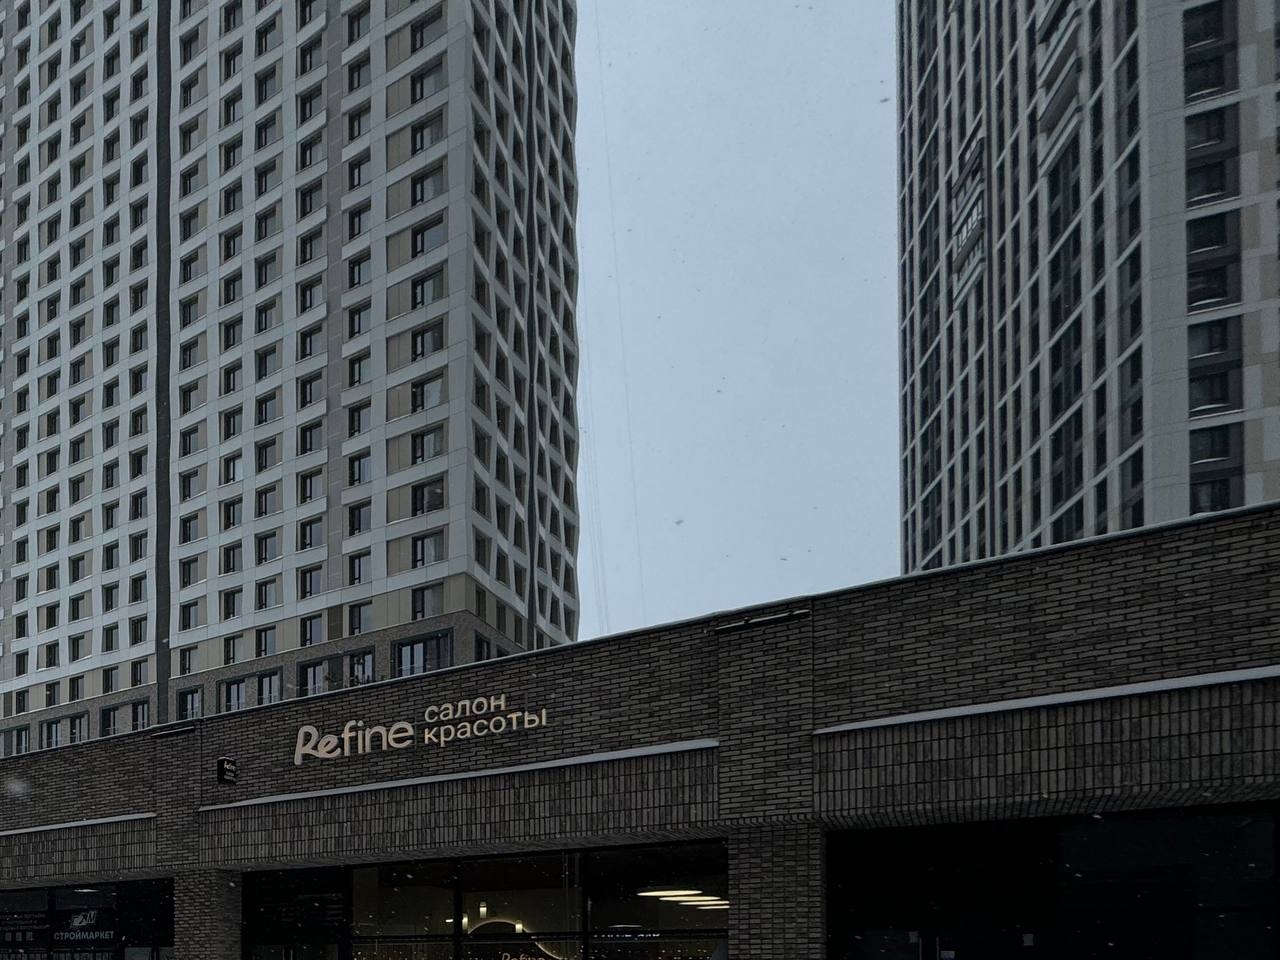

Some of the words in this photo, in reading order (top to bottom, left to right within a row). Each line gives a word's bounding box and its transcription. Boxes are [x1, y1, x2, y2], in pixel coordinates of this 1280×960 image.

[424, 693, 506, 723] салон
[293, 719, 414, 766] Refine
[424, 708, 547, 747] красоты
[53, 930, 115, 941] СТРОЙМАРКЕТ
